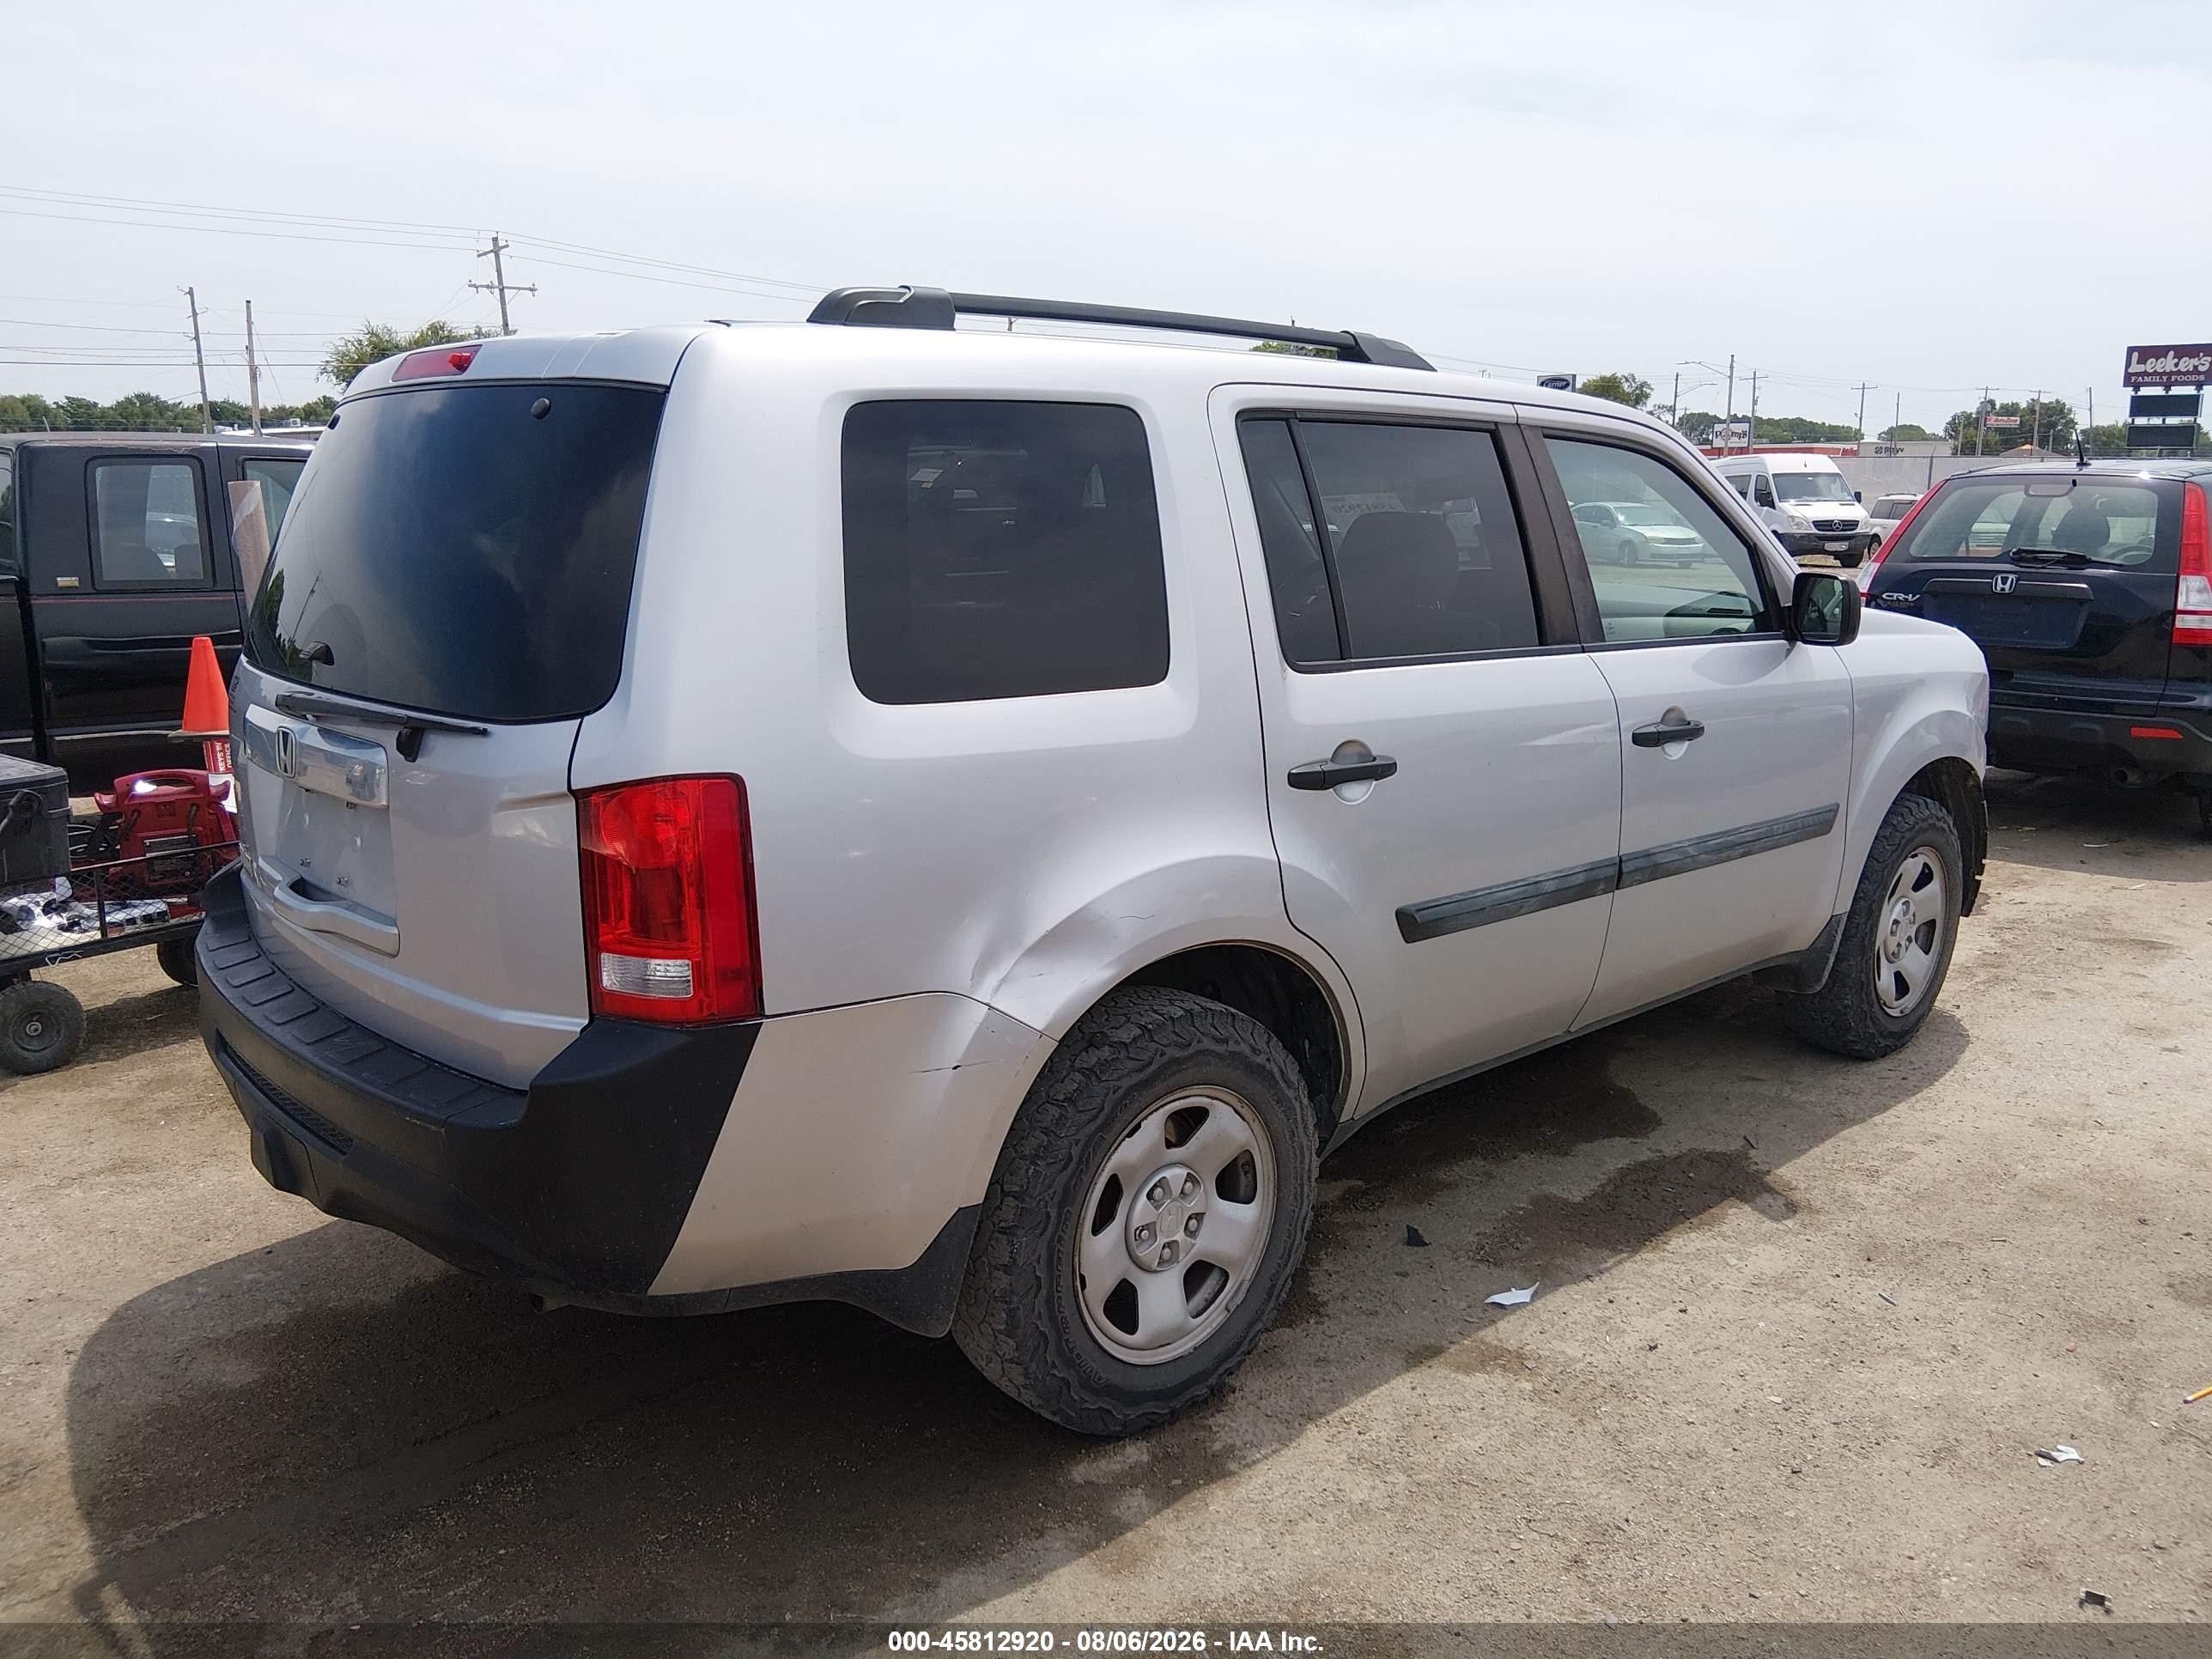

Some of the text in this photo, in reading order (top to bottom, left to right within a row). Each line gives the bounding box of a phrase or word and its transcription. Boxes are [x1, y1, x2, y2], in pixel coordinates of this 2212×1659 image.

[2128, 350, 2212, 373] Leeker's
[1881, 592, 1921, 602] CR-V
[216, 750, 226, 771] KEYS
